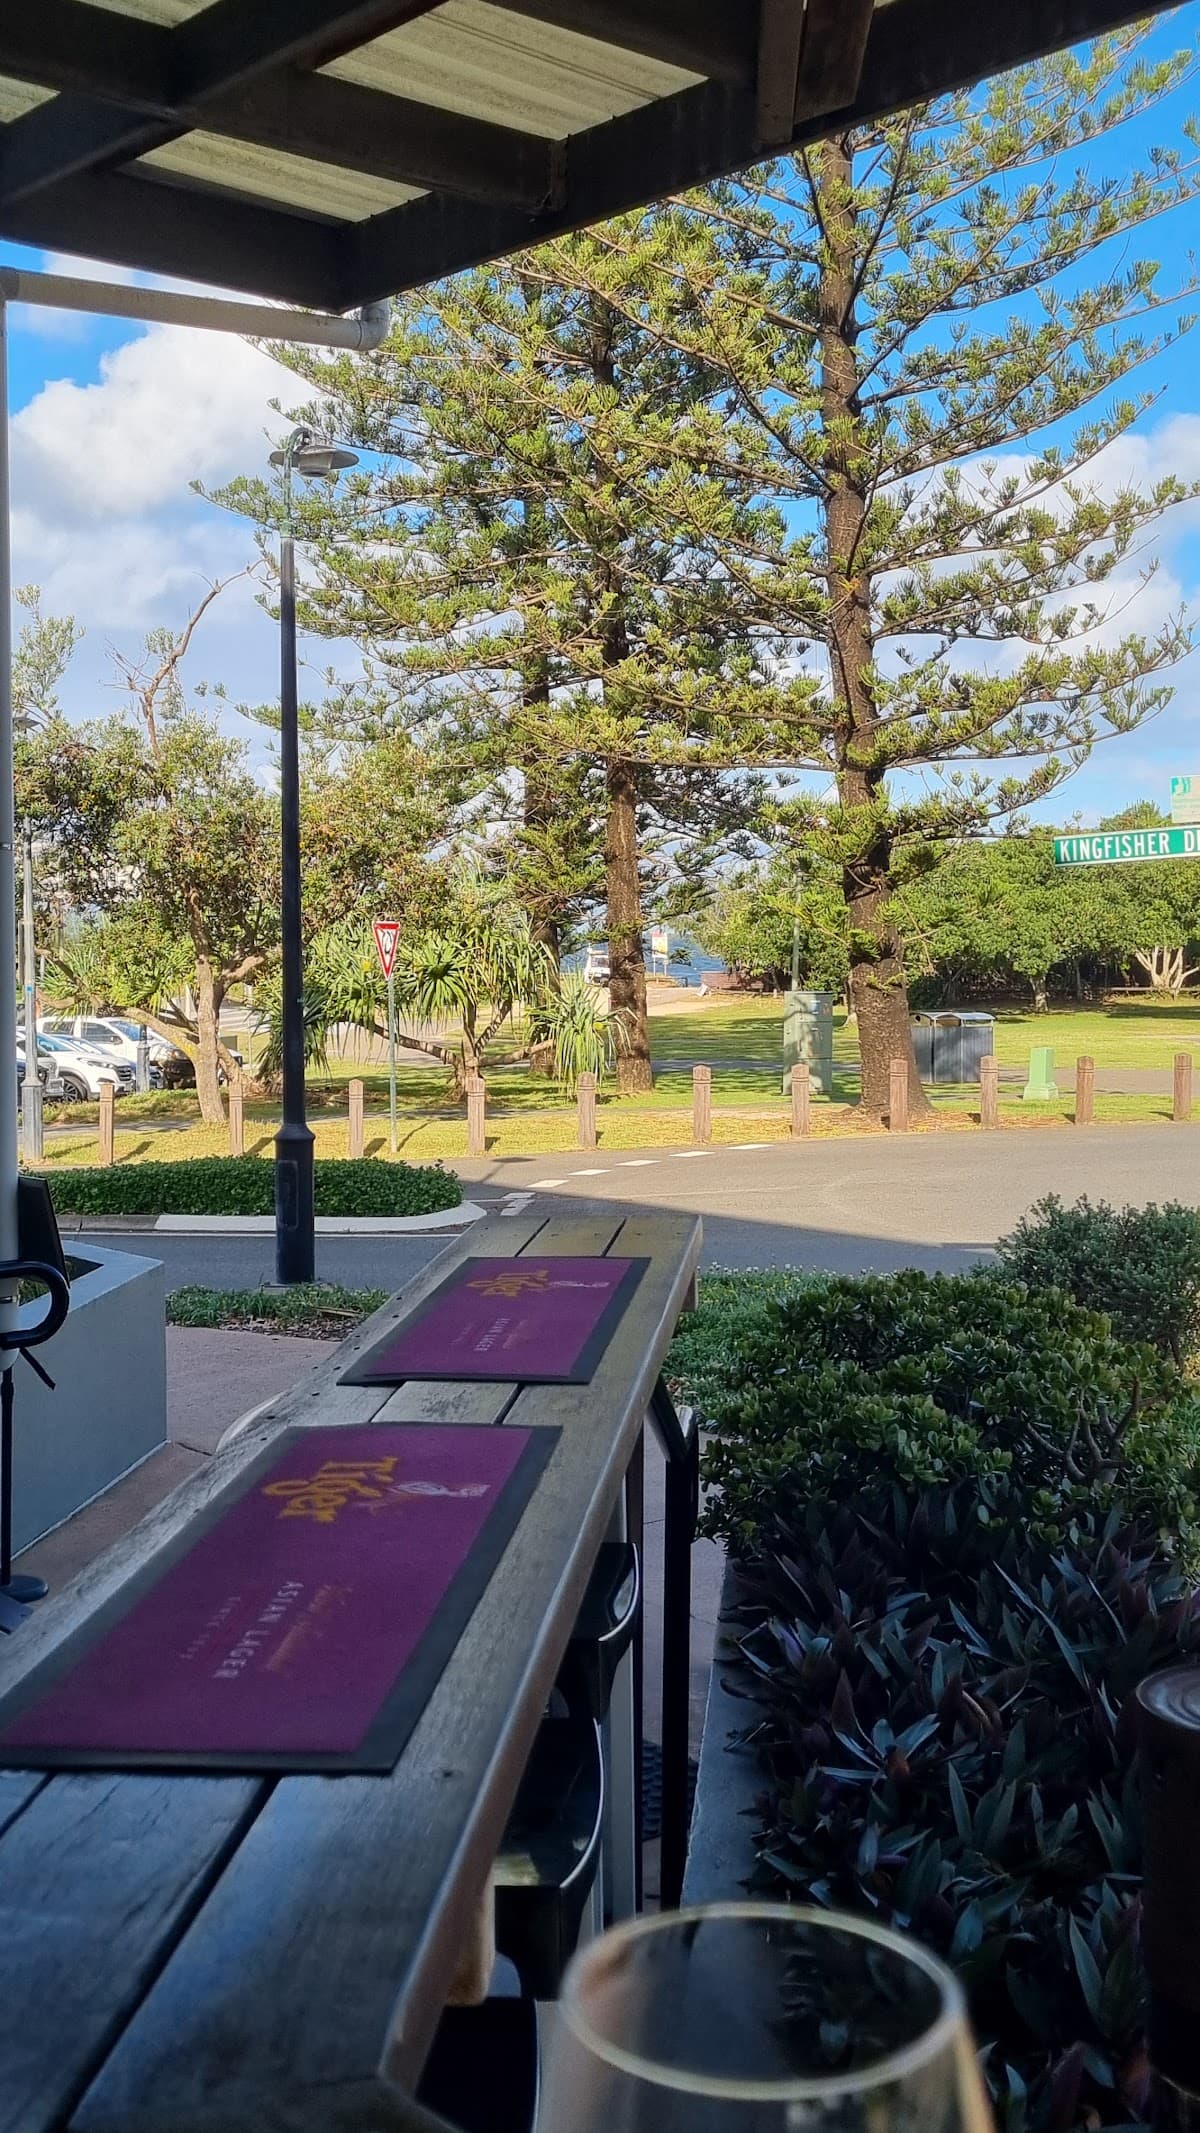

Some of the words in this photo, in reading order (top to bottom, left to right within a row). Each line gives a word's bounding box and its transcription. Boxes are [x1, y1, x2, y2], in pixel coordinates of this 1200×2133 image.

[1060, 832, 1170, 862] KINGFISHER
[1184, 830, 1200, 852] D
[264, 1456, 398, 1522] Tiger
[257, 1580, 304, 1622] ASIAN
[211, 1630, 271, 1679] LAGER
